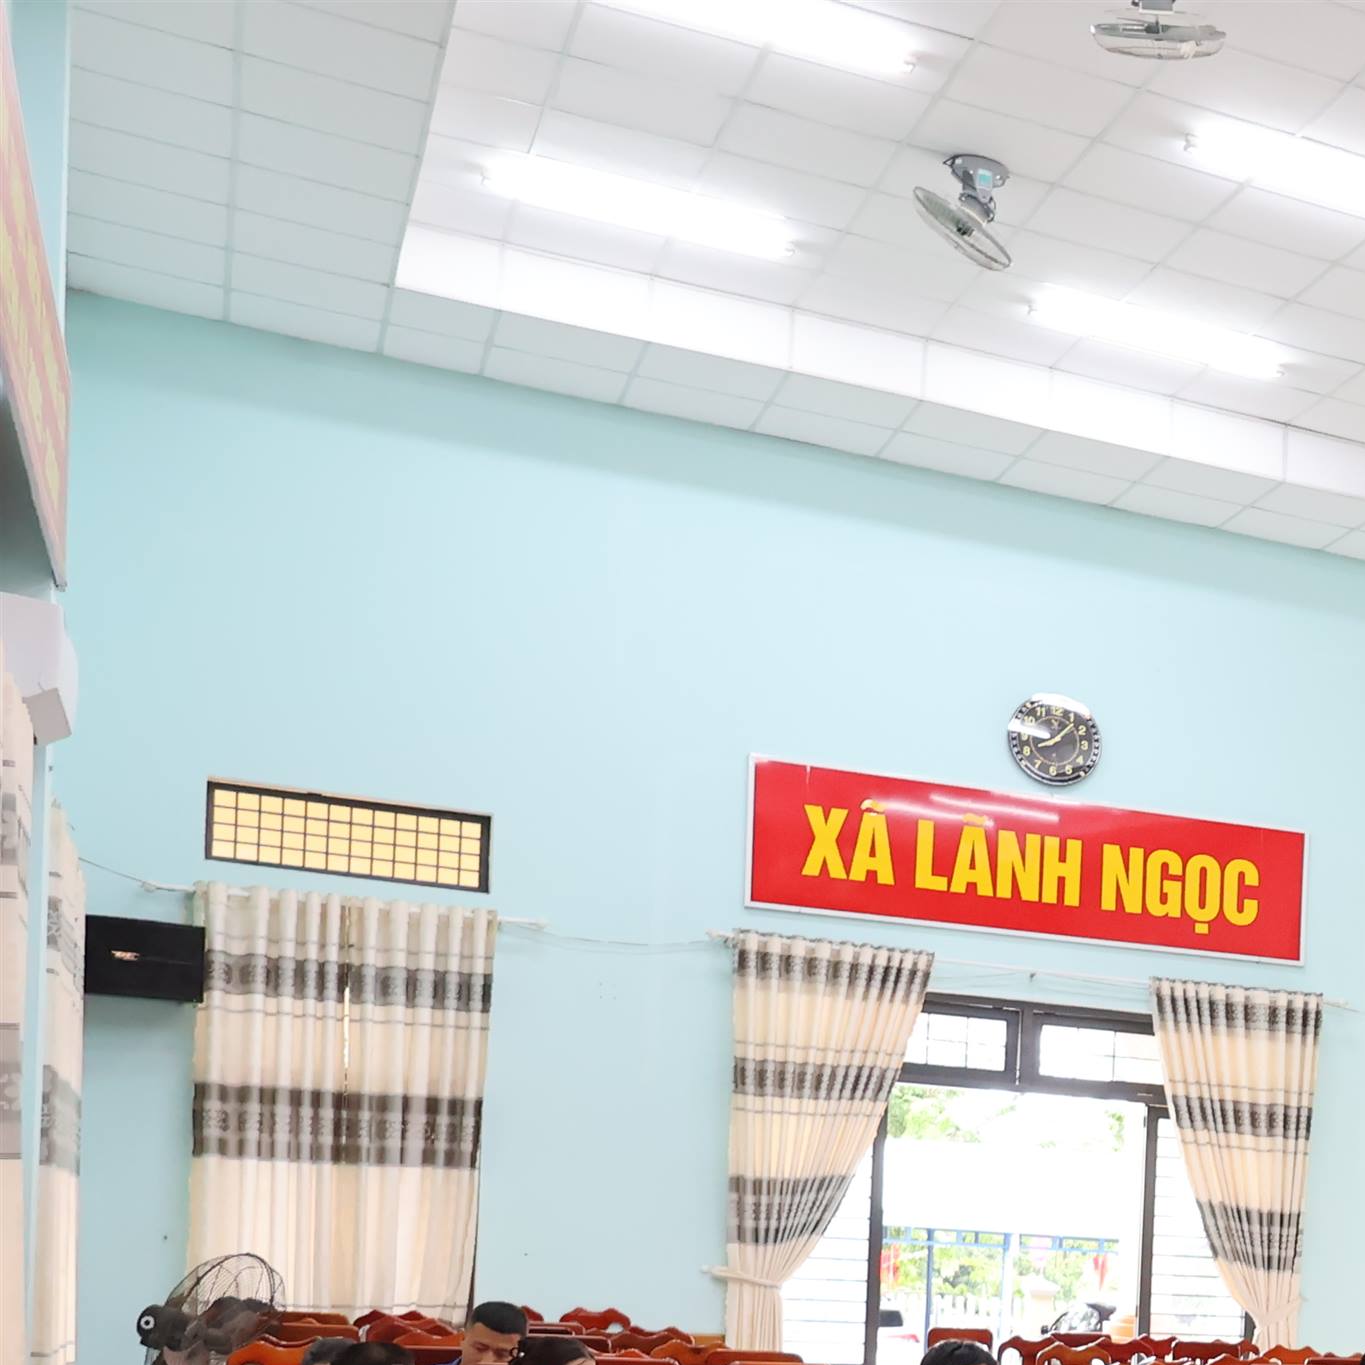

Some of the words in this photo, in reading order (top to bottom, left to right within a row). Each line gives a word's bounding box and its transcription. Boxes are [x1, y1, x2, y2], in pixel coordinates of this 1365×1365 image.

[1078, 725, 1086, 735] 2
[1081, 740, 1088, 750] 3
[1023, 746, 1030, 756] 8
[801, 798, 895, 886] XÃ
[914, 812, 1083, 907] LÃNH
[1101, 842, 1260, 935] NGỌC
